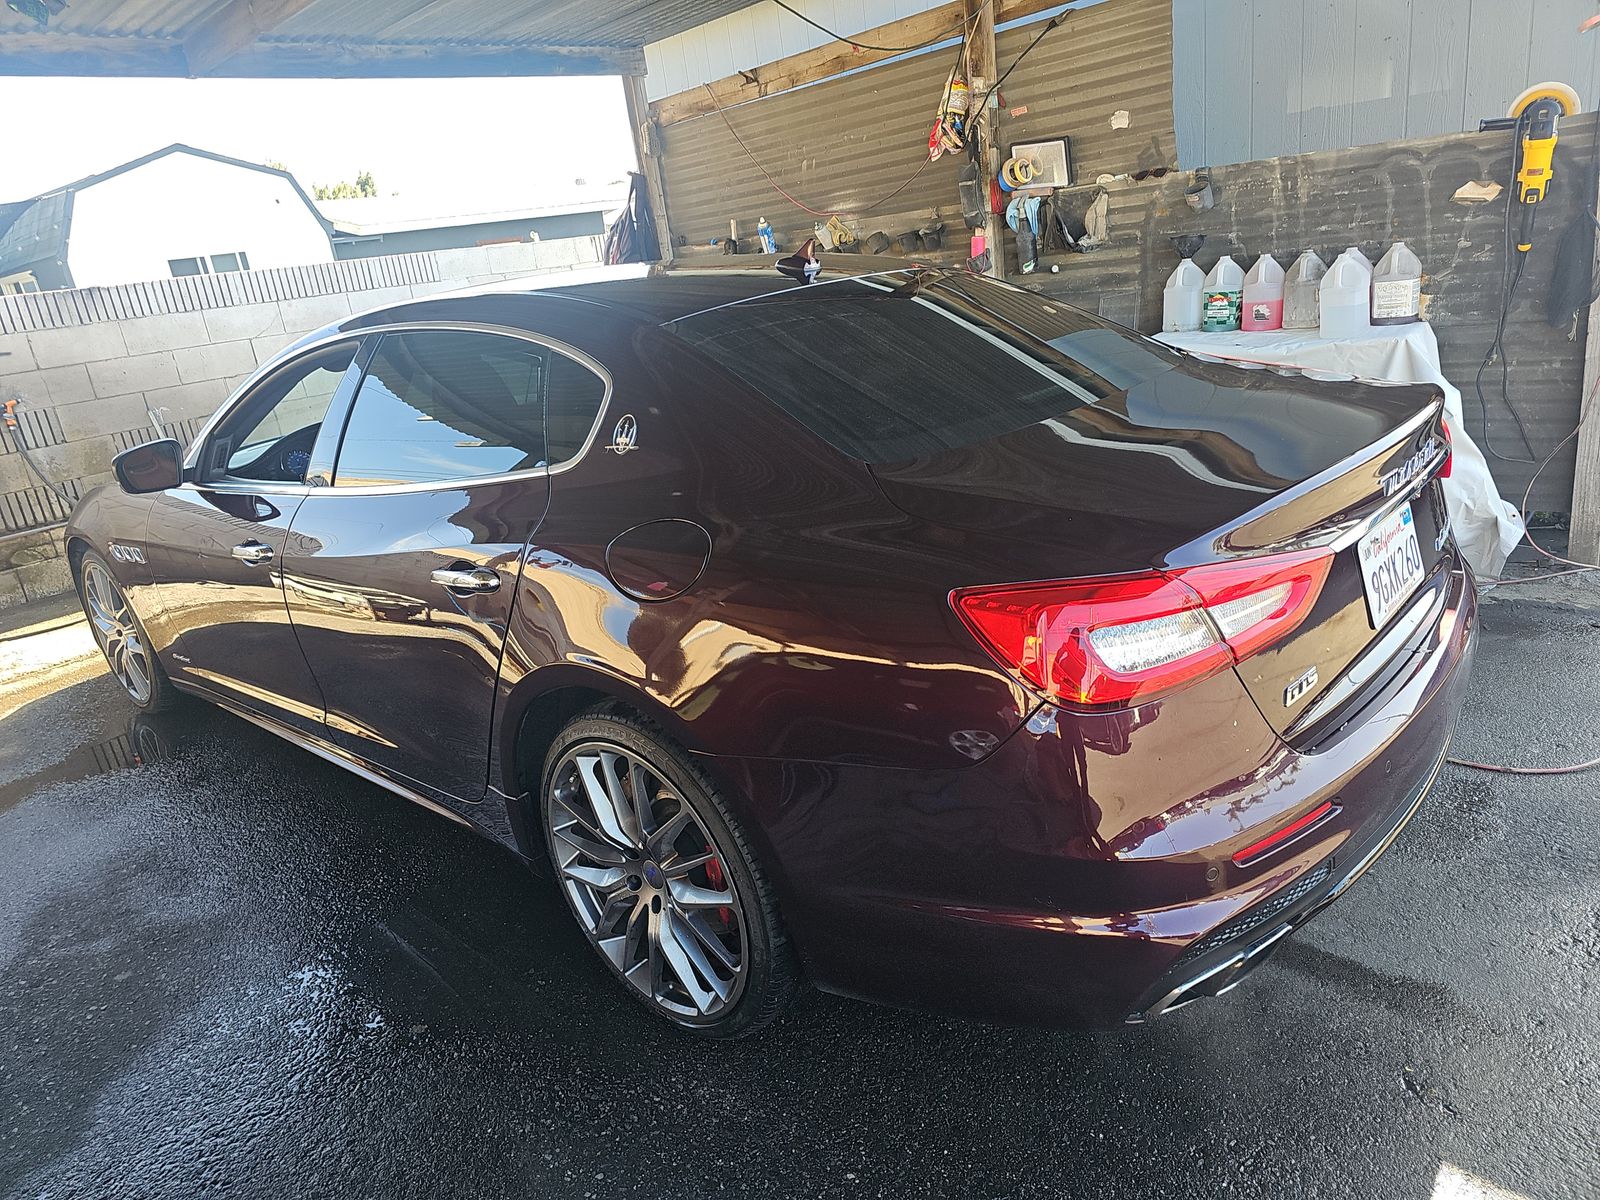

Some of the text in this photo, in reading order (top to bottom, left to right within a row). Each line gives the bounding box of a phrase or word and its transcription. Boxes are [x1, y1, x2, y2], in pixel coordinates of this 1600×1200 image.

[1380, 437, 1435, 497] Maserati
[1372, 522, 1405, 558] California
[1371, 534, 1420, 614] 9GXK260
[1283, 665, 1319, 708] GTS
